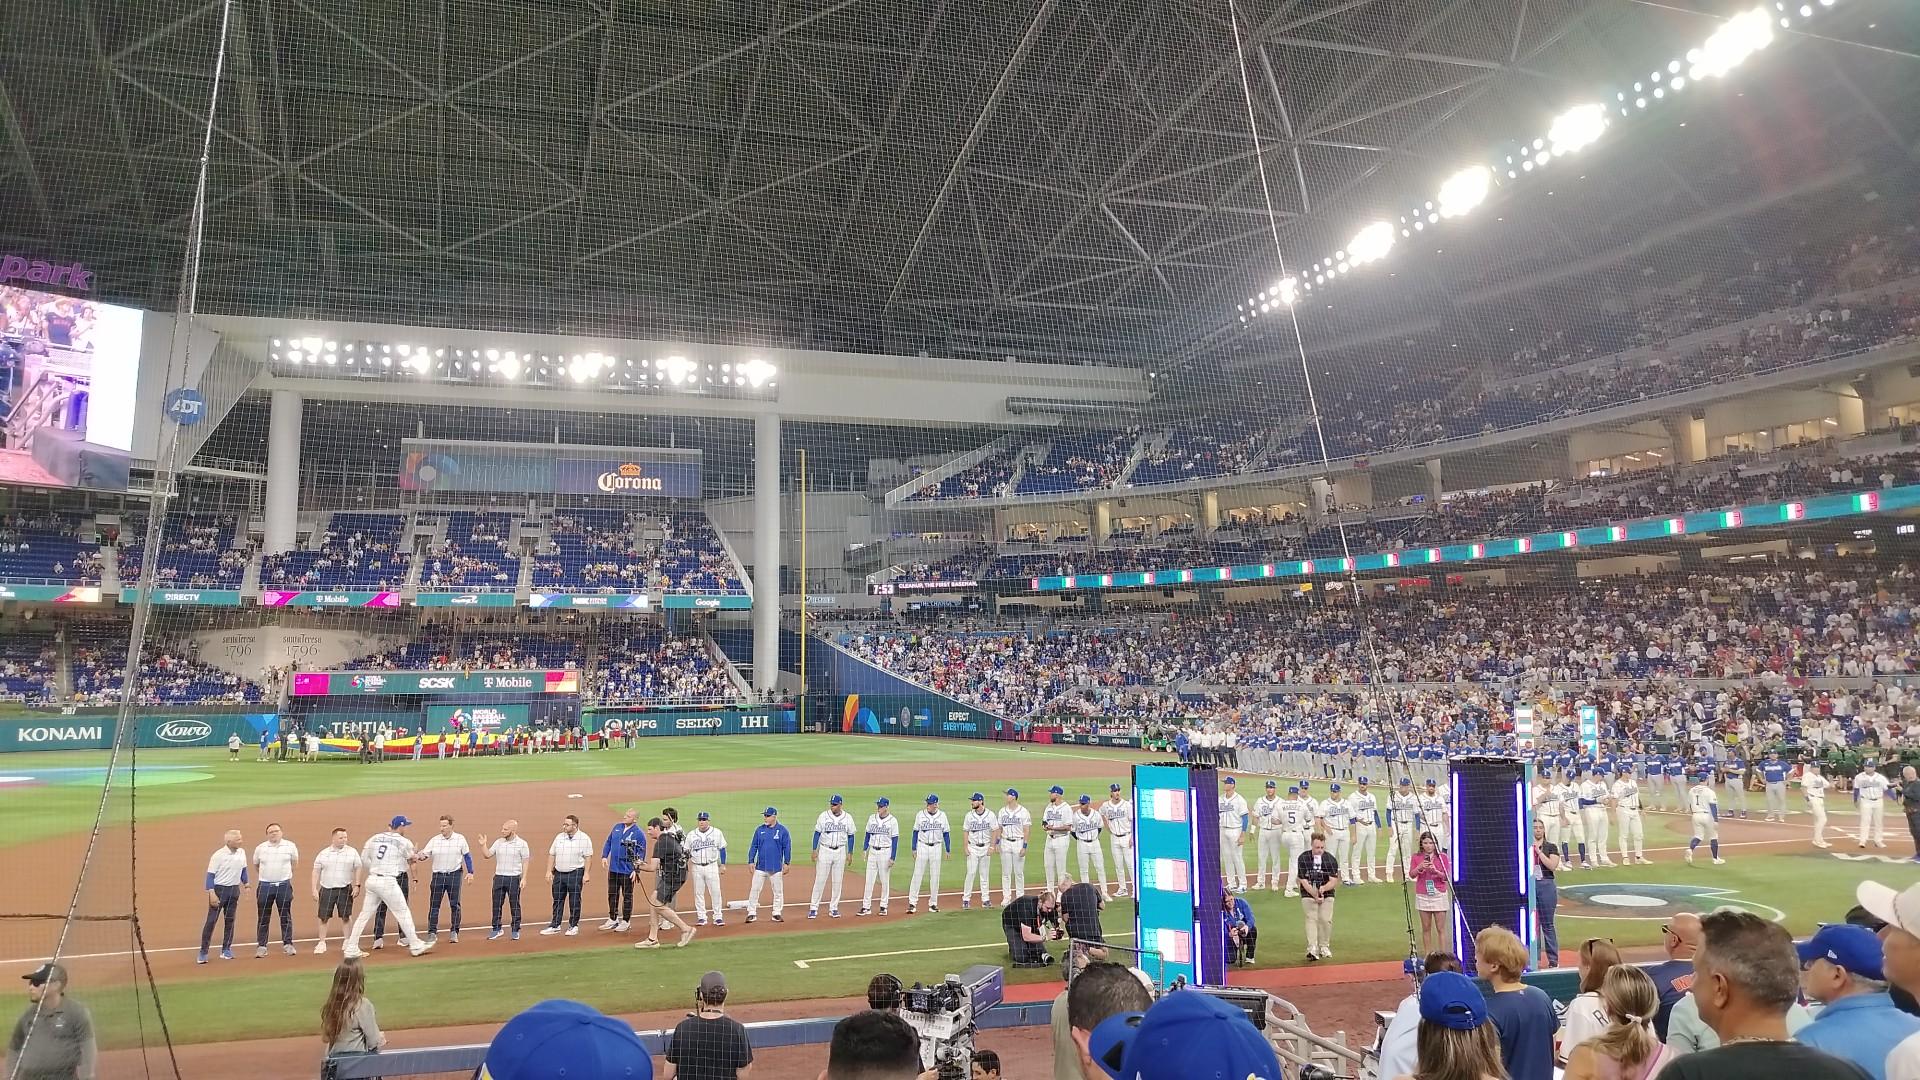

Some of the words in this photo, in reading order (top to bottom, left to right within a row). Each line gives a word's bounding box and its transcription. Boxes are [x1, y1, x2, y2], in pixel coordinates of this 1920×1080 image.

[0, 254, 94, 290] park
[171, 399, 202, 415] ADT
[597, 472, 662, 494] Corona
[873, 584, 894, 595] 7:53
[165, 593, 200, 601] DIRECTV
[695, 597, 720, 607] Google
[224, 643, 252, 660] 1796
[286, 643, 318, 660] 1796
[418, 677, 455, 689] SCSK
[495, 676, 532, 688] Mobile
[741, 715, 769, 728] IHI
[948, 711, 970, 721] EXPECT
[675, 717, 722, 729] SEIKO
[943, 721, 977, 732] EVERYTHING
[18, 726, 102, 742] KONAMI
[160, 723, 209, 737] Kowa
[1287, 811, 1296, 825] 5
[376, 844, 388, 860] 9
